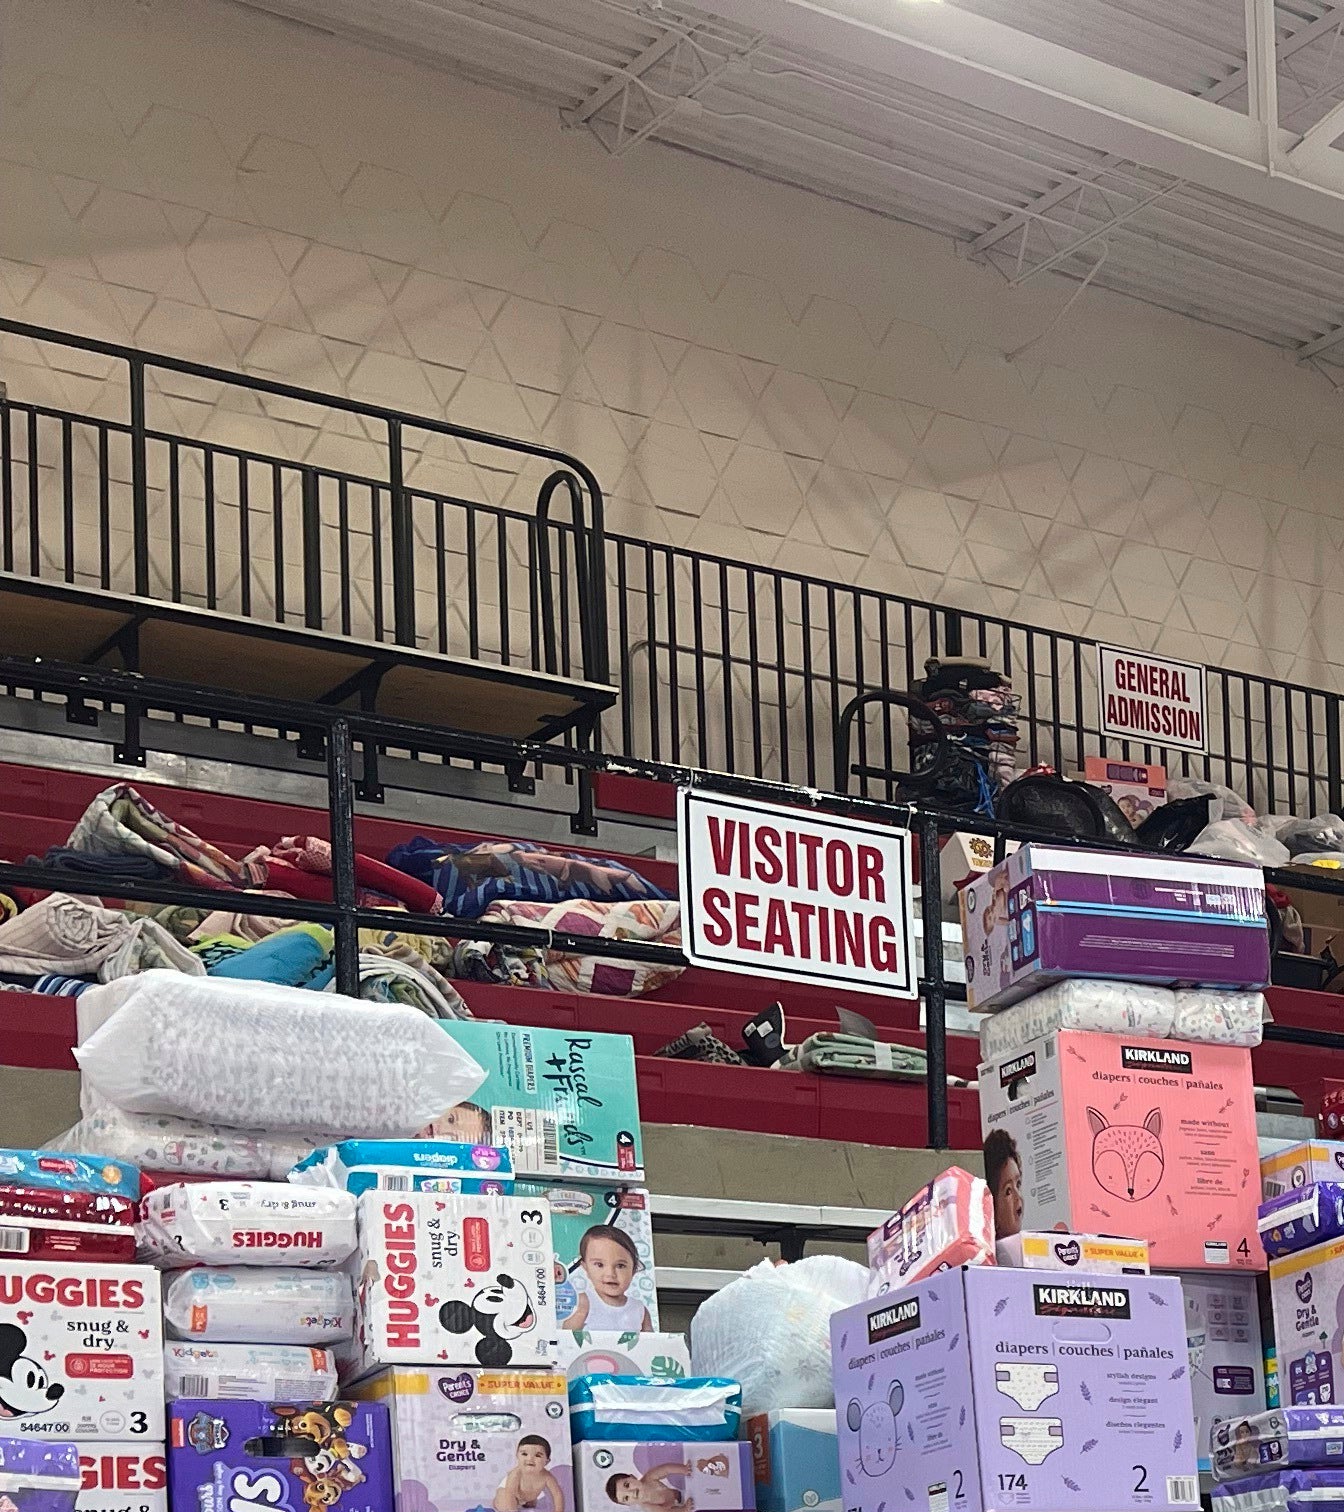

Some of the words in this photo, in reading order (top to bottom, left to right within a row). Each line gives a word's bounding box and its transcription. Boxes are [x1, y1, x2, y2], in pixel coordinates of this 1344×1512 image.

[1114, 658, 1191, 703] GENERAL
[1106, 693, 1201, 741] ADMISSION
[707, 816, 886, 903] VISITOR
[702, 888, 898, 973] SEATING
[1125, 1049, 1189, 1065] KIRKLAND
[1092, 1070, 1130, 1084] diapers
[1138, 1074, 1179, 1088] couches
[428, 1218, 440, 1231] &
[232, 1231, 322, 1249] HUGGIES
[444, 1230, 460, 1257] dry
[430, 1236, 443, 1268] snug
[384, 1203, 420, 1348] HUGGIES
[1039, 1289, 1127, 1307] KIRKLAND
[67, 1321, 112, 1334] snug
[116, 1320, 129, 1333] &
[869, 1305, 918, 1332] KIRKLAND
[83, 1334, 115, 1350] dry
[848, 1354, 876, 1370] diapers
[880, 1341, 911, 1359] couches
[915, 1329, 946, 1349] pañales
[995, 1341, 1049, 1357] diapers
[1059, 1343, 1114, 1358] couches
[1124, 1346, 1174, 1360] pañales
[130, 1412, 148, 1433] 3
[439, 1439, 470, 1452] Dry
[472, 1439, 481, 1450] &
[436, 1449, 486, 1463] Gentle
[998, 1474, 1028, 1492] 174
[1132, 1465, 1150, 1493] 2
